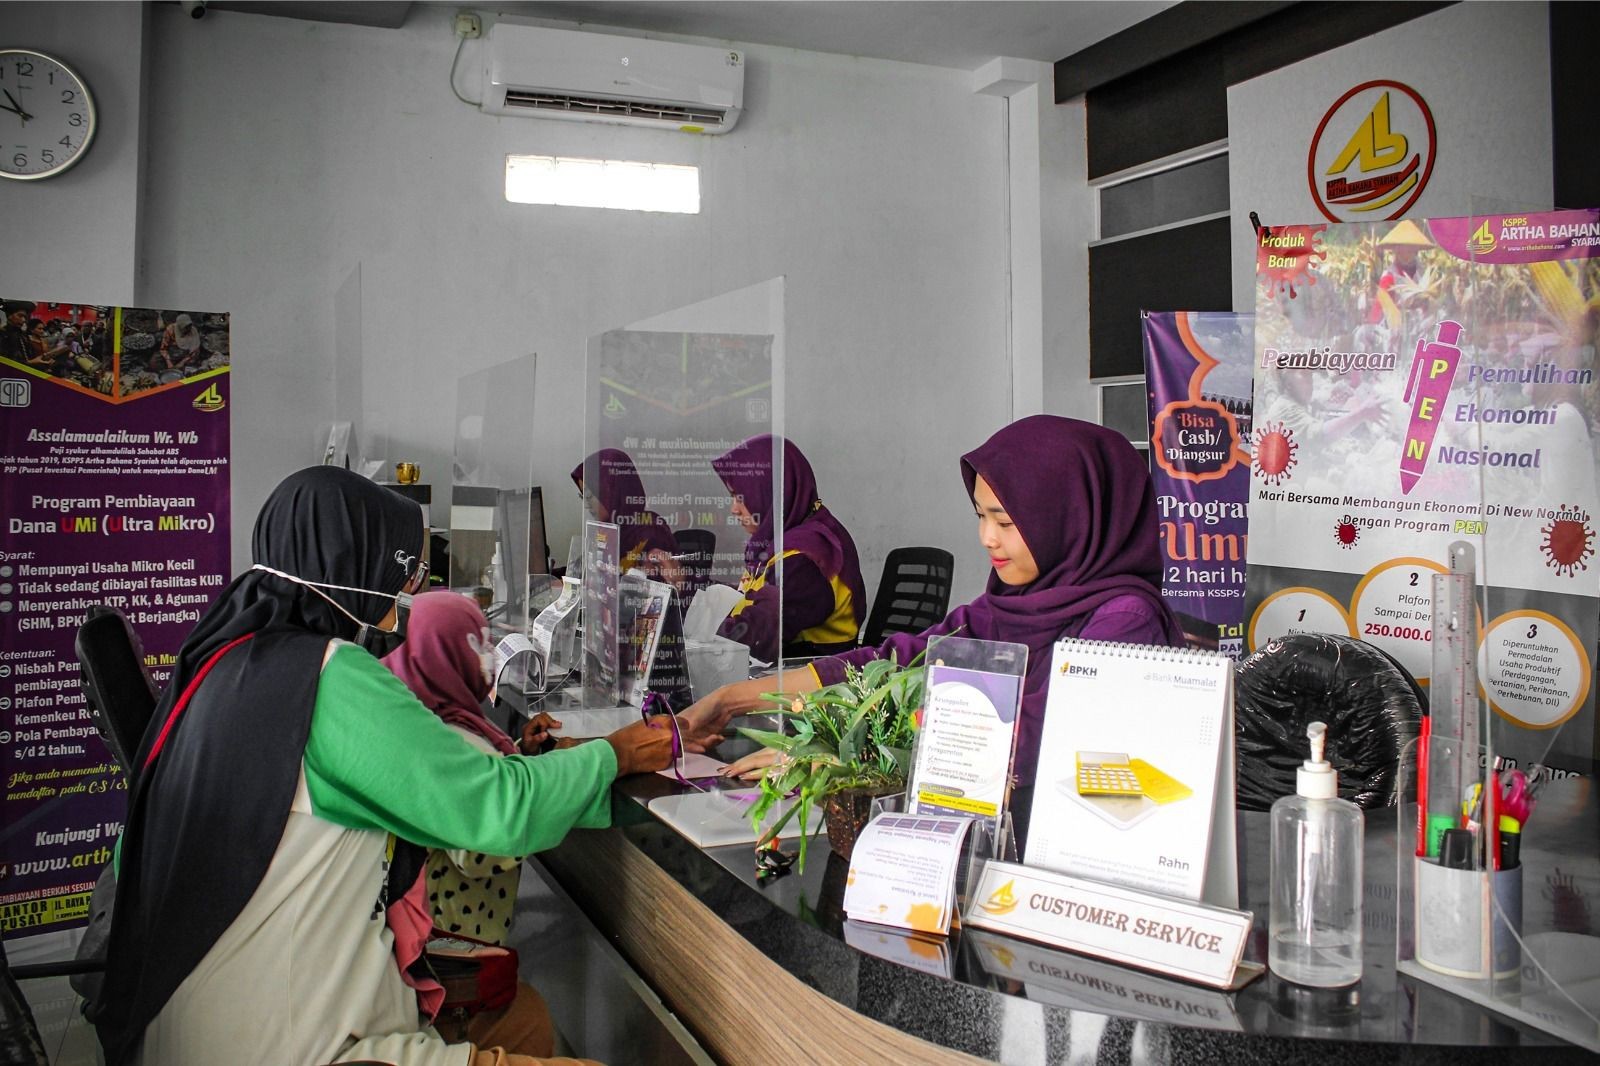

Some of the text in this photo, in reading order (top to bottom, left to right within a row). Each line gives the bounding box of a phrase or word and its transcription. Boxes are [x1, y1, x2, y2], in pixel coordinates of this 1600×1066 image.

[16, 62, 34, 76] 12
[48, 72, 54, 85] 1
[62, 90, 74, 104] 2
[69, 113, 82, 127] 3
[59, 135, 72, 148] 4
[14, 153, 28, 167] 6
[42, 149, 54, 163] 5
[1502, 217, 1527, 227] KSPPS
[1261, 233, 1305, 247] Produk
[1500, 225, 1545, 240] ARTHA
[1268, 254, 1297, 268] Baru
[1261, 348, 1396, 375] Pembiayaan
[1468, 363, 1592, 385] Pemulihan
[1177, 412, 1216, 428] Bisa
[1455, 403, 1558, 425] Ekonomi
[27, 428, 199, 444] Assalamualaikum Wr. Wb
[1178, 429, 1223, 447] Cash/
[50, 446, 65, 455] Puji
[65, 446, 89, 455] syukur
[1166, 448, 1226, 464] Diangsur
[1437, 445, 1541, 468] Nasional
[17, 456, 39, 464] tahun
[40, 456, 60, 465] 2019,
[106, 457, 133, 465] Bahana
[133, 457, 159, 465] Syariah
[179, 457, 212, 466] dipercaya
[18, 466, 43, 475] (Pusat
[44, 466, 76, 474] Investasi
[77, 467, 121, 475] Pemerintah)
[142, 467, 186, 475] menyalurkan
[31, 494, 196, 513] Program Pembiayaan
[1156, 495, 1249, 525] Progra
[1258, 490, 1586, 522] Mari Bersama Membangun Ekonomi Di New Normal
[9, 512, 215, 536] Dana UMi (Ultra Mikro)
[1343, 514, 1489, 535] Dengan Program PEN
[1159, 522, 1248, 562] Um
[18, 559, 195, 578] Mempunyai Usaha Mikro Kecil
[1186, 567, 1226, 583] hari
[18, 575, 224, 596] Tidak sedang dibiayai fasilitas KUR
[1409, 572, 1419, 587] 2
[1161, 588, 1240, 598] Bersama KSSPS
[1398, 594, 1431, 606] Plafon
[18, 593, 209, 614] Menyerahkan KTP, KK, & Agunan
[138, 609, 200, 624] Berjangka)
[1297, 609, 1307, 622] 1
[1374, 606, 1413, 620] Sampai
[17, 615, 88, 633] (SHM, BPK
[1526, 624, 1537, 639] 3
[1502, 639, 1559, 654] Diperuntukkan
[1507, 650, 1553, 663] Permodalan
[15, 662, 55, 676] Nisbah
[1069, 665, 1098, 677] BPKH
[1499, 659, 1561, 676] Usaha Produktif
[1152, 671, 1173, 683] Bank
[1173, 675, 1217, 688] Muamalat
[1501, 669, 1557, 686] (Perdagangan,
[15, 678, 81, 695] pembiayaa
[1528, 684, 1570, 699] Perikanan,
[15, 696, 53, 709] Plafon
[1545, 697, 1560, 708] Dll)
[15, 711, 76, 725] Kemenkeu
[15, 725, 99, 743] Pola Pembaya
[15, 744, 85, 760] s/d 2 tahun.
[7, 763, 107, 789] Jika anda memenuhi
[7, 786, 56, 800] mendaftar
[60, 783, 86, 798] pada
[35, 823, 101, 847] Kunjungi
[1158, 855, 1190, 872] Rahn
[42, 885, 70, 898] BERKAH
[66, 897, 82, 910] RAYA
[1, 913, 43, 930] PUSAT
[1028, 892, 1223, 954] CUSTOMER SERVICE
